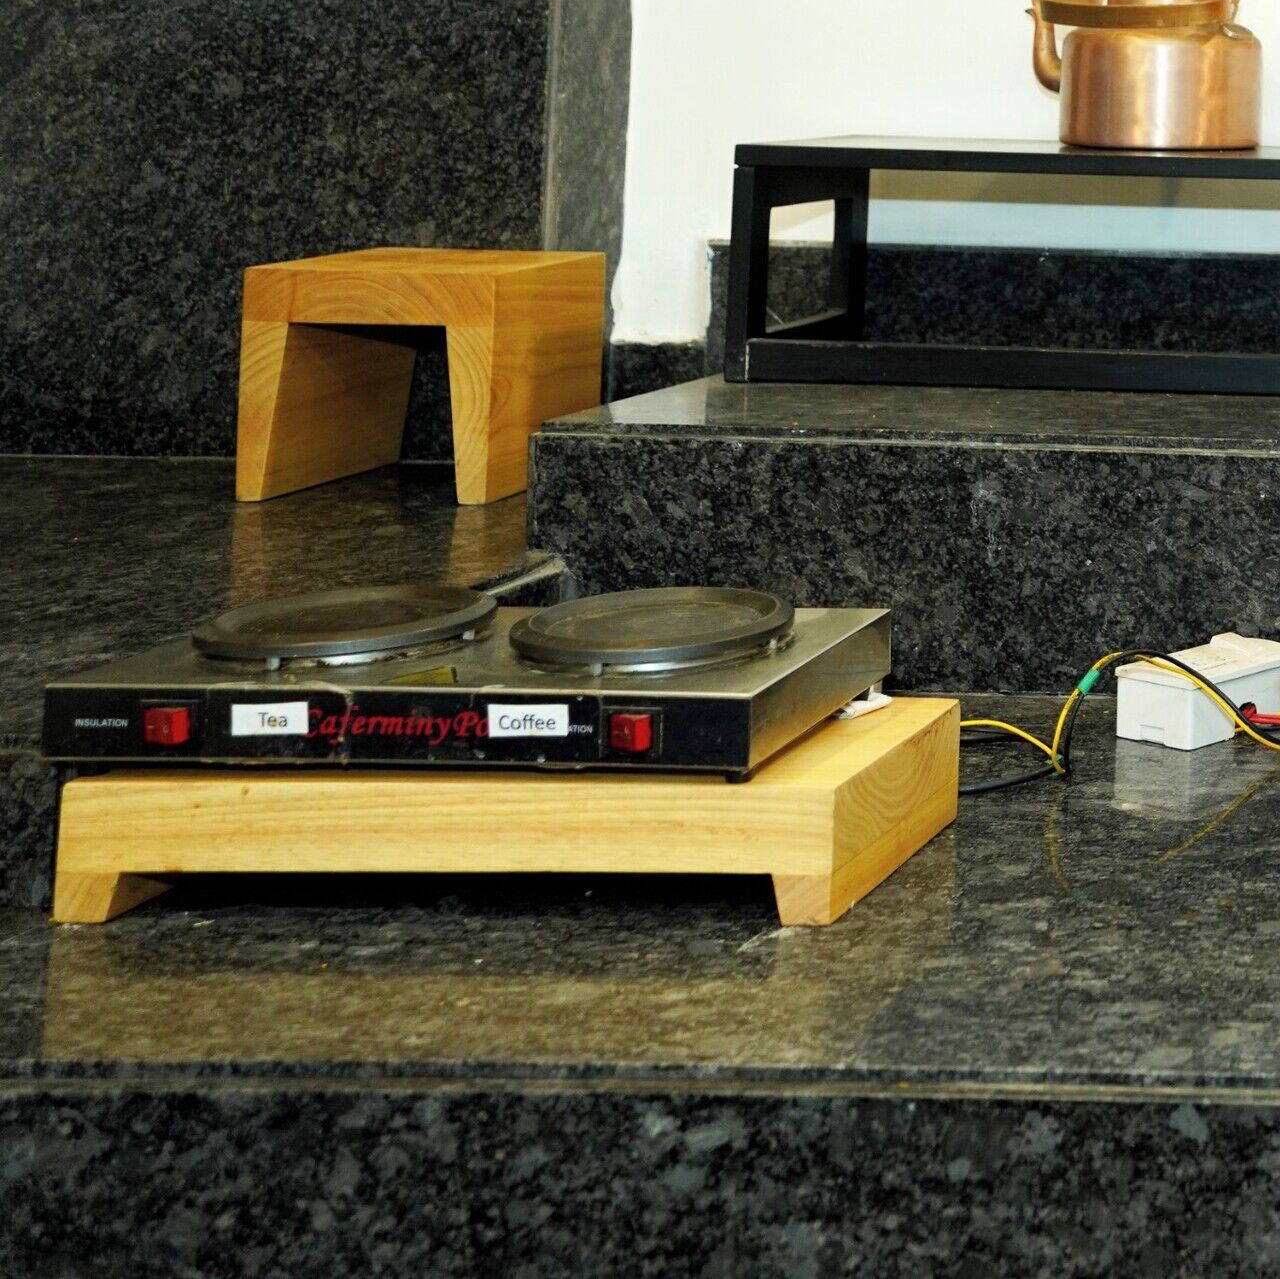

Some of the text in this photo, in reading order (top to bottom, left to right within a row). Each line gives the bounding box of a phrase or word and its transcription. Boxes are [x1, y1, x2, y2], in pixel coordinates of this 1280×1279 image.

[75, 719, 129, 728] INSULATION
[258, 712, 288, 728] Tea
[499, 714, 556, 730] Coffee
